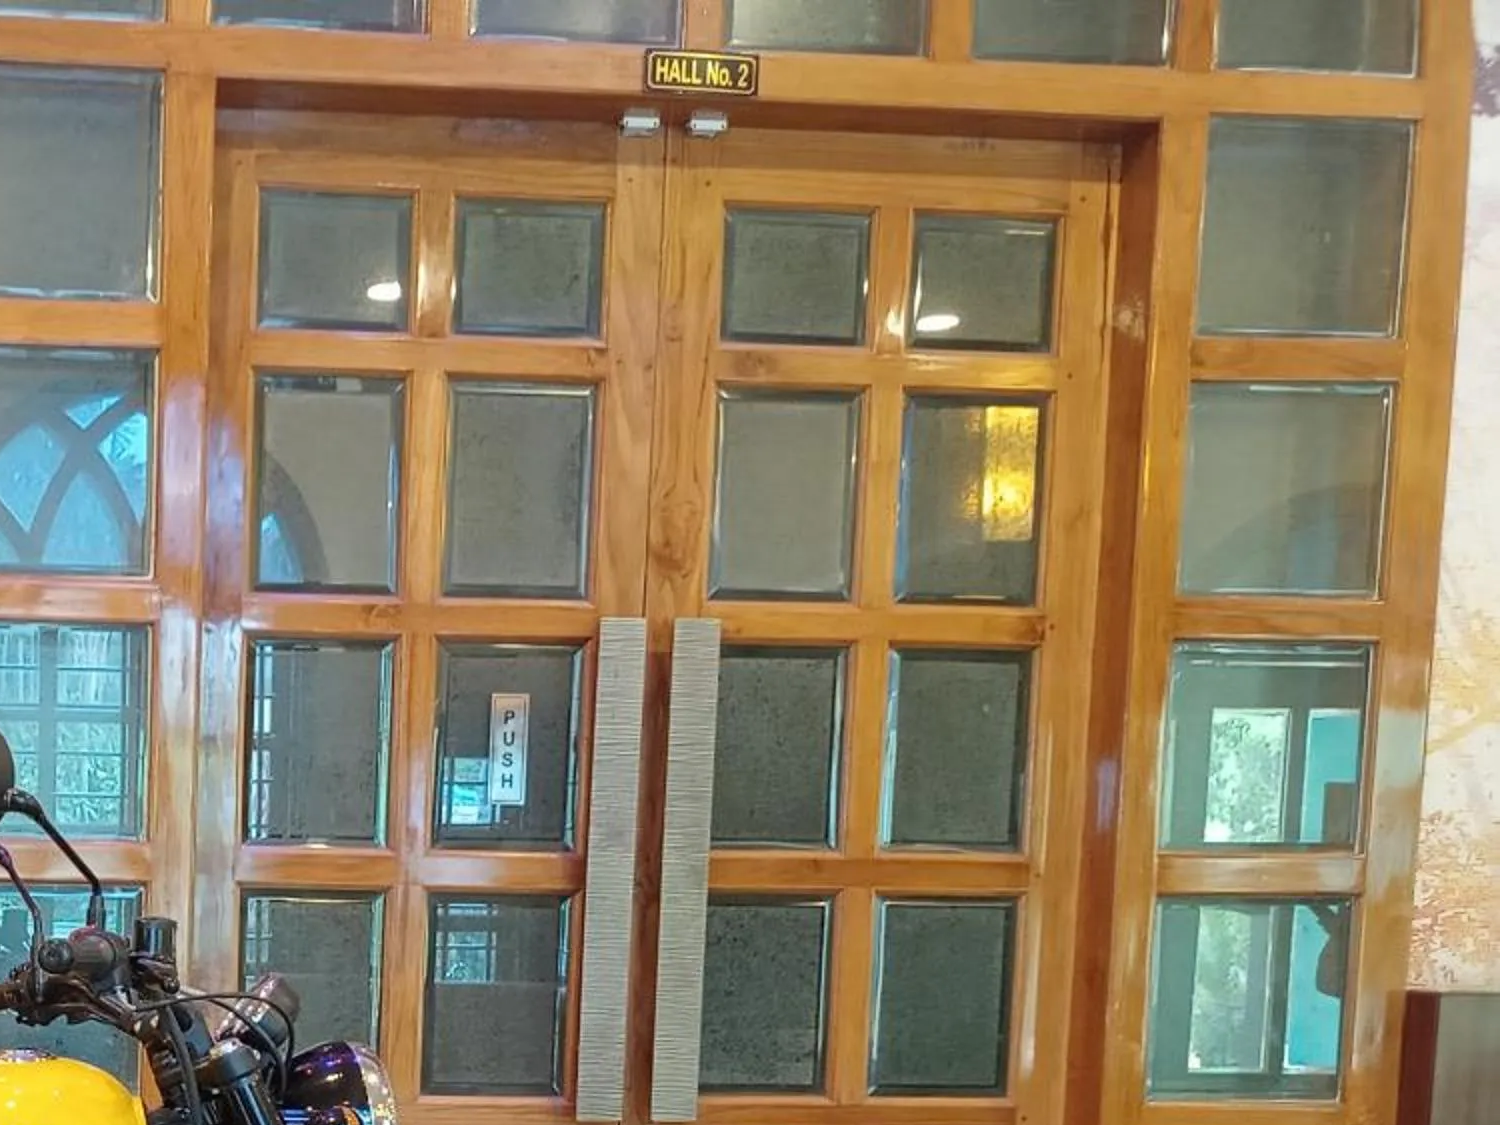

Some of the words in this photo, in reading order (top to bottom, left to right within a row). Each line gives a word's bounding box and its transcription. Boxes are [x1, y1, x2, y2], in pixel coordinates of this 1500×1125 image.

[654, 57, 702, 84] HALL
[706, 60, 733, 87] No.
[737, 63, 749, 88] 2
[501, 709, 515, 790] PUSH
